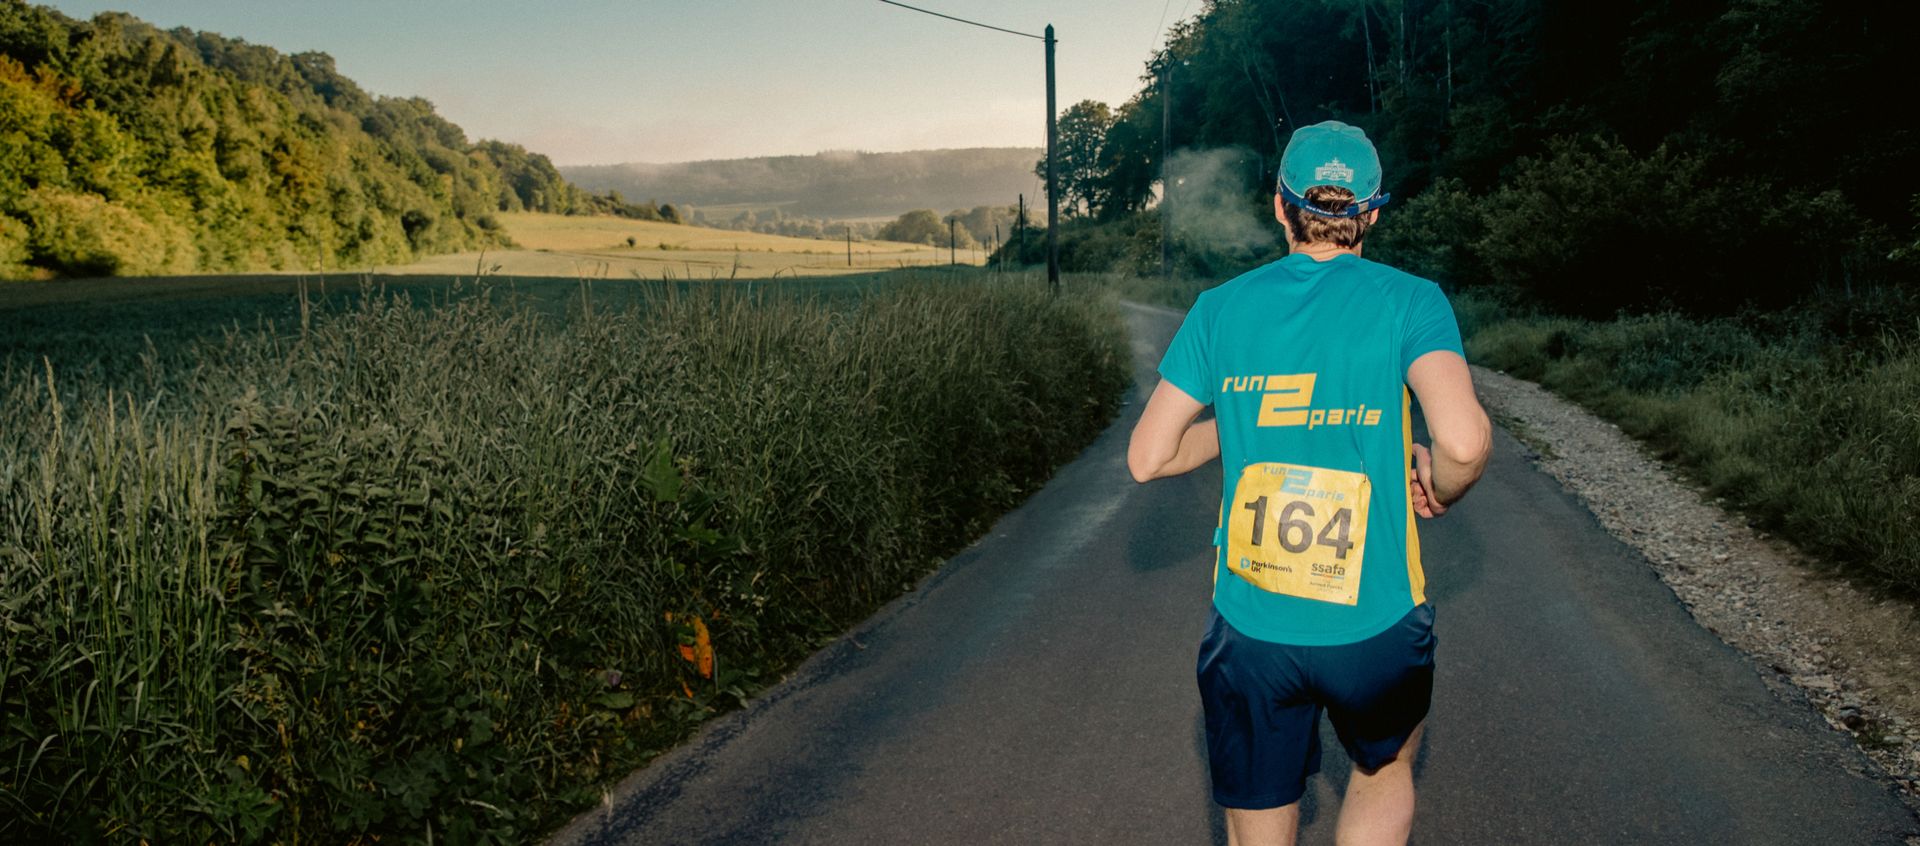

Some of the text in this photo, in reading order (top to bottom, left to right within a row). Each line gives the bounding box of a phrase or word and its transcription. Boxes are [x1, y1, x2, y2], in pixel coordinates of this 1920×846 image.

[1244, 495, 1354, 561] 164
[1251, 560, 1293, 573] Parkinson's
[1251, 566, 1262, 574] UK
[1311, 562, 1346, 576] ssafa
